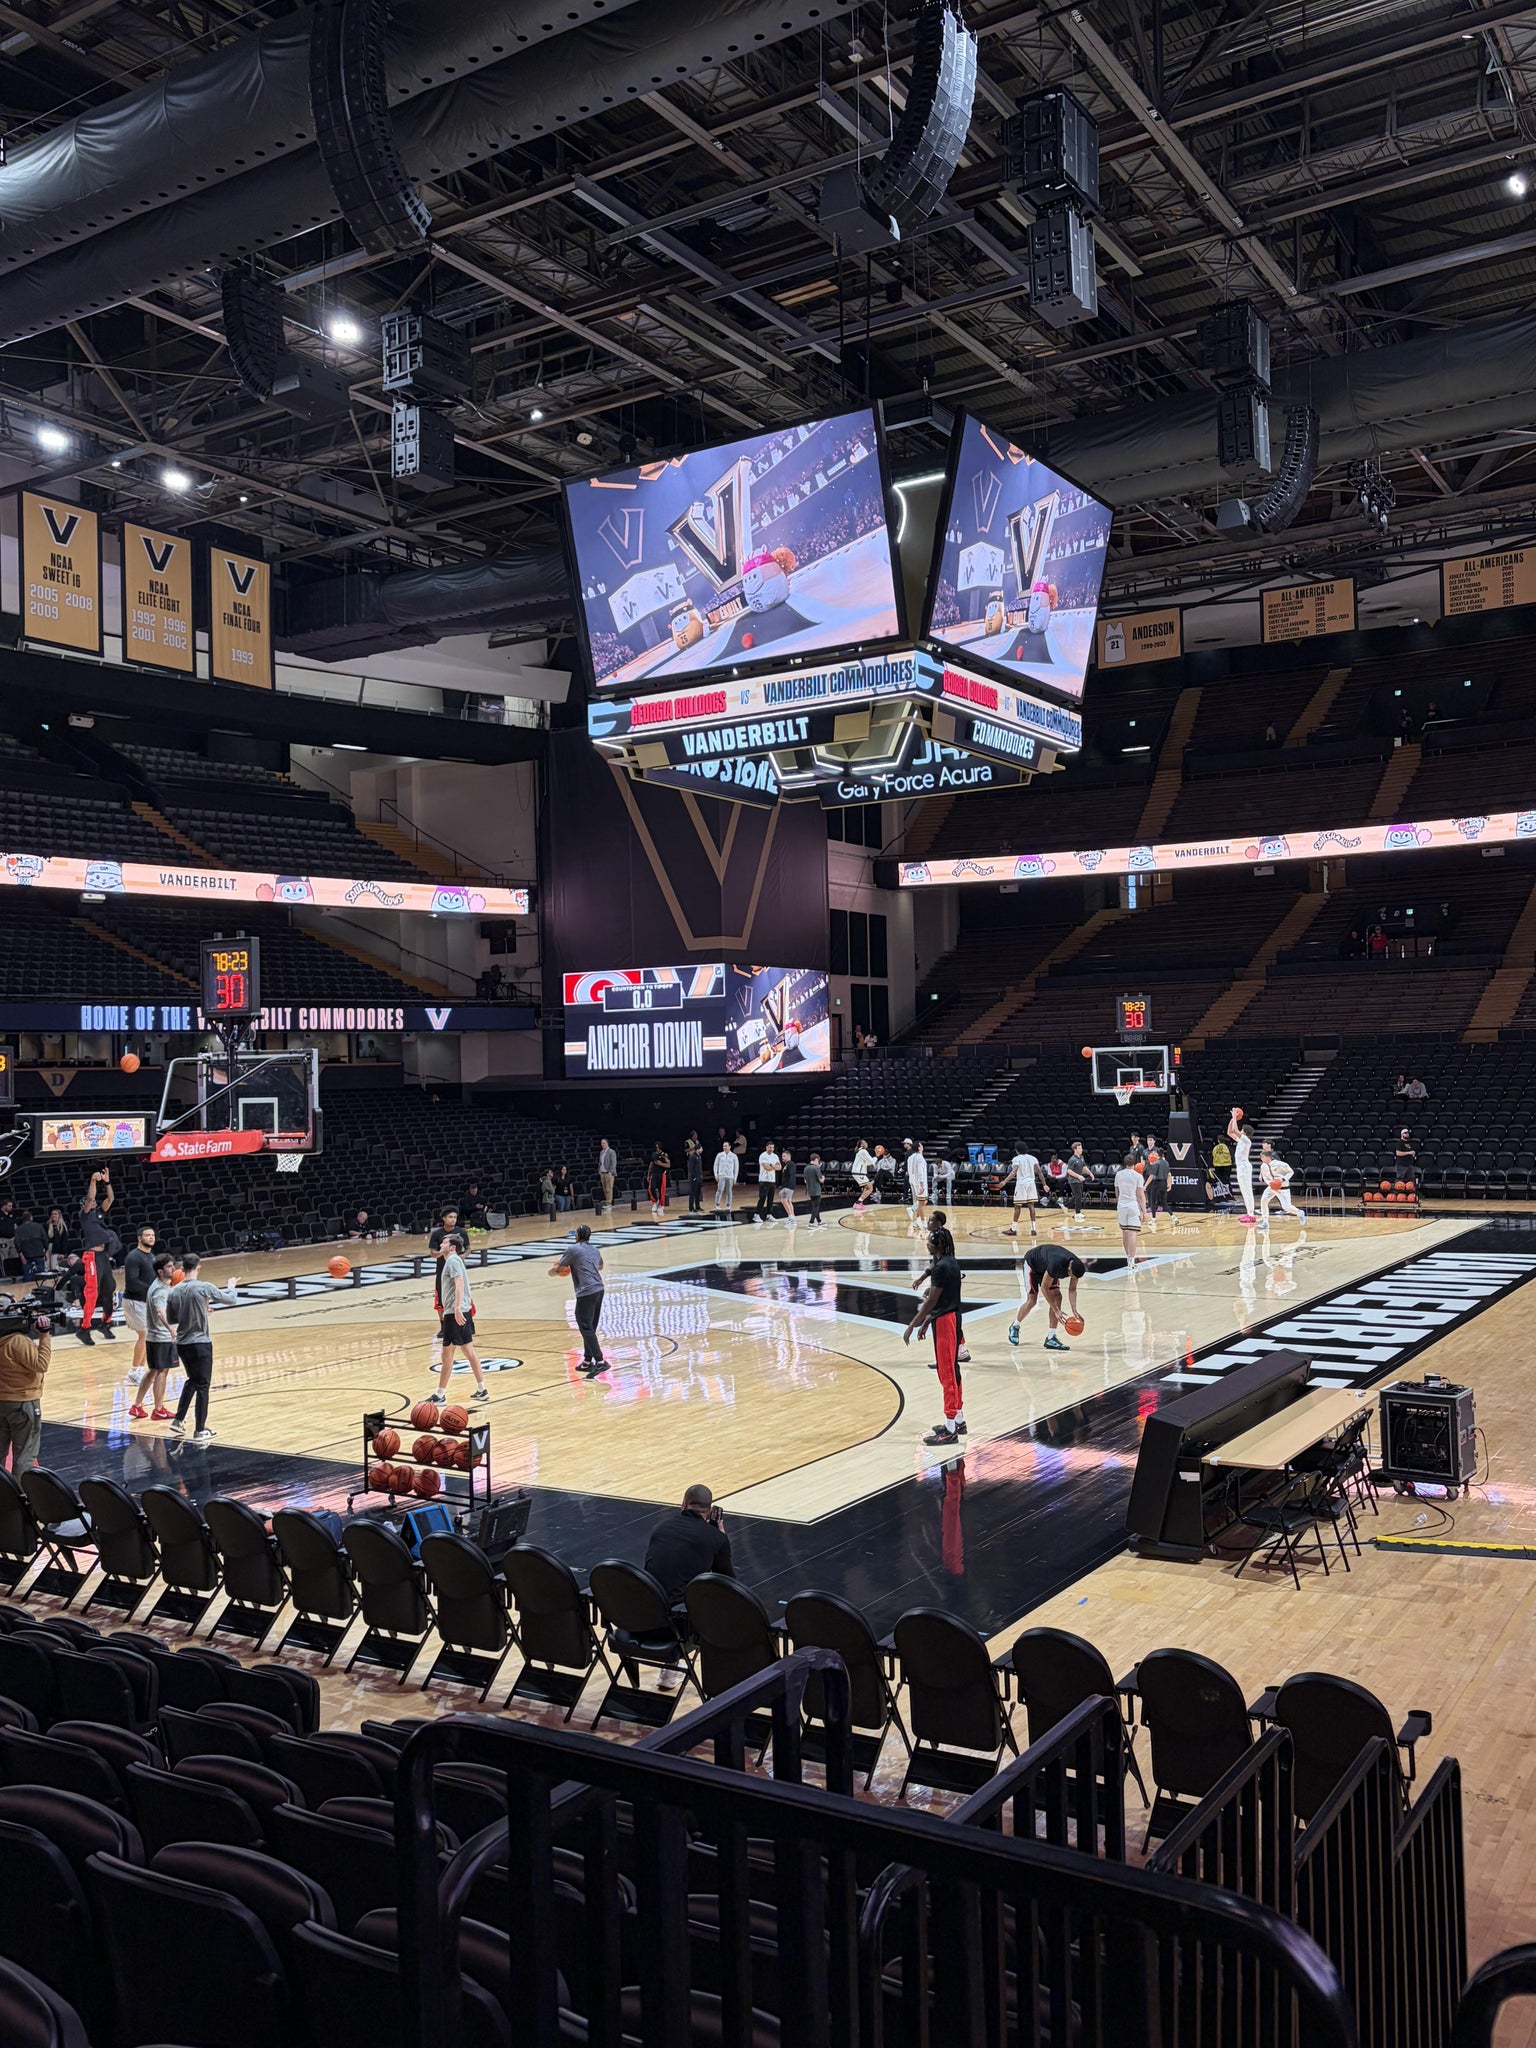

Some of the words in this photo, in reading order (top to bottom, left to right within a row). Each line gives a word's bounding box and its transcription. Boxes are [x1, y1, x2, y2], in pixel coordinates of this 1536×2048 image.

[39, 504, 82, 547] V
[50, 552, 73, 571] NCAA
[139, 534, 177, 574] V
[1464, 553, 1524, 572] ALL-AMERICANS
[42, 566, 70, 585] SWEET
[72, 573, 81, 588] 16
[149, 579, 169, 596] NCAA
[224, 558, 259, 596] V
[30, 583, 58, 602] 2005
[65, 592, 93, 611] 2008
[138, 591, 157, 608] ELITE
[160, 596, 180, 613] EIGHT
[1281, 584, 1334, 601] ALL-AMERICANS
[30, 601, 58, 619] 2009
[232, 601, 251, 618] NCAA
[132, 608, 156, 627] 1992
[163, 616, 187, 634] 1996
[223, 612, 242, 629] FINAL
[243, 618, 261, 634] FOUR
[1132, 621, 1174, 640] ANDERSON
[132, 625, 156, 643] 2001
[163, 633, 187, 650] 2002
[1110, 640, 1120, 650] 21
[231, 648, 254, 665] 1993
[630, 699, 674, 726] GEORGIA
[674, 690, 727, 720] BULLDOGS
[740, 689, 750, 705] VS
[763, 673, 828, 706] VANDERBILT
[829, 659, 915, 695] COMMODORES
[943, 670, 969, 700] GEORGIA
[1015, 696, 1046, 726] VANDERBILT
[1045, 707, 1081, 740] COMMODORES
[681, 716, 810, 756] VANDERBILT
[971, 720, 1035, 760] COMMODORES
[884, 773, 935, 794] Force
[939, 765, 992, 787] Acura
[1174, 846, 1230, 859] VANDERBILT
[159, 873, 238, 891] VANDERBILT
[216, 974, 244, 1009] 30
[632, 990, 652, 1009] 0.0
[81, 1006, 129, 1031] HOME
[135, 1006, 155, 1031] OF
[161, 1007, 191, 1031] THE
[299, 1007, 404, 1030] COMMODORES
[425, 1008, 452, 1031] V
[1125, 1012, 1144, 1028] 30
[587, 1022, 650, 1070] ANCHOR
[653, 1020, 703, 1068] DOWN
[51, 1073, 65, 1087] D
[1169, 1143, 1192, 1161] V
[1171, 1175, 1199, 1185] Hiller
[473, 1429, 489, 1450] V
